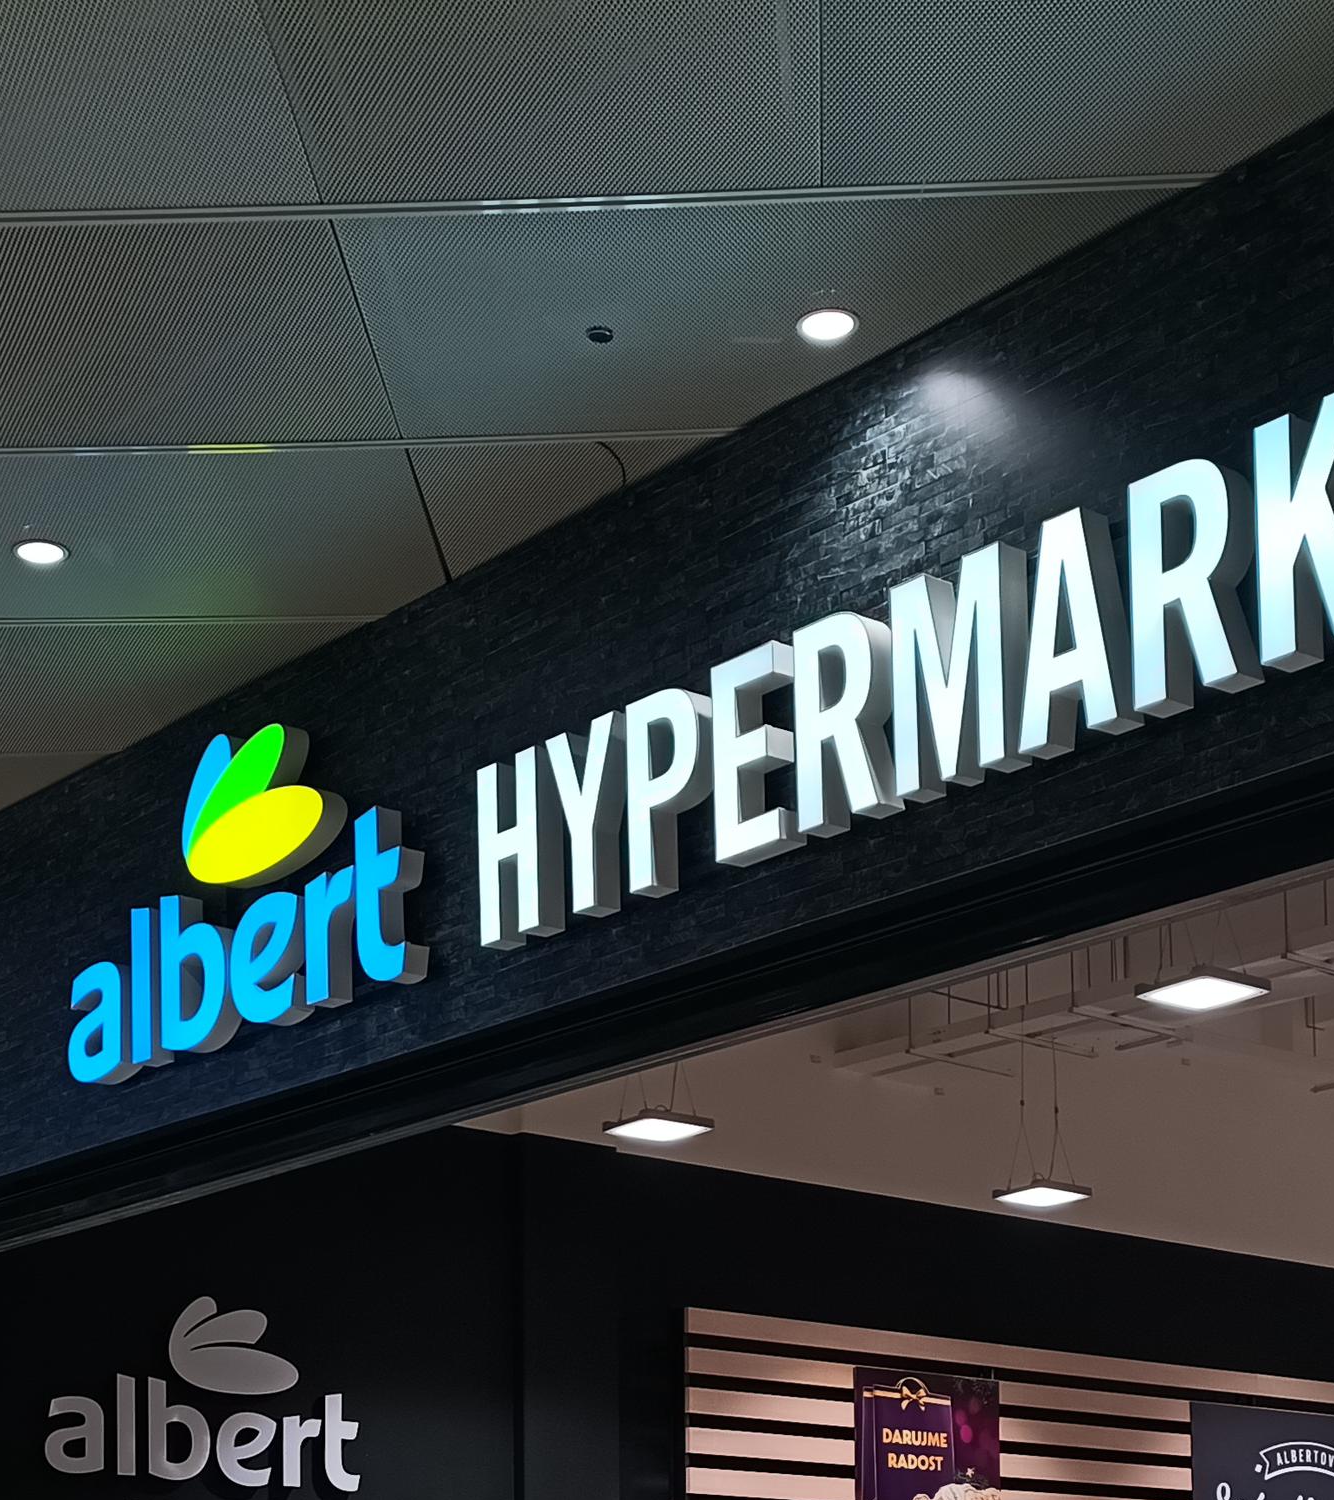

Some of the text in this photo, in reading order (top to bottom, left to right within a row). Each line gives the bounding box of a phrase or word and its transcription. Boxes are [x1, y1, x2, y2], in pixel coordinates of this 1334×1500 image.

[67, 805, 425, 1084] albert
[44, 1372, 361, 1493] albert
[882, 1428, 948, 1448] DARUJME
[887, 1453, 943, 1471] RADOST
